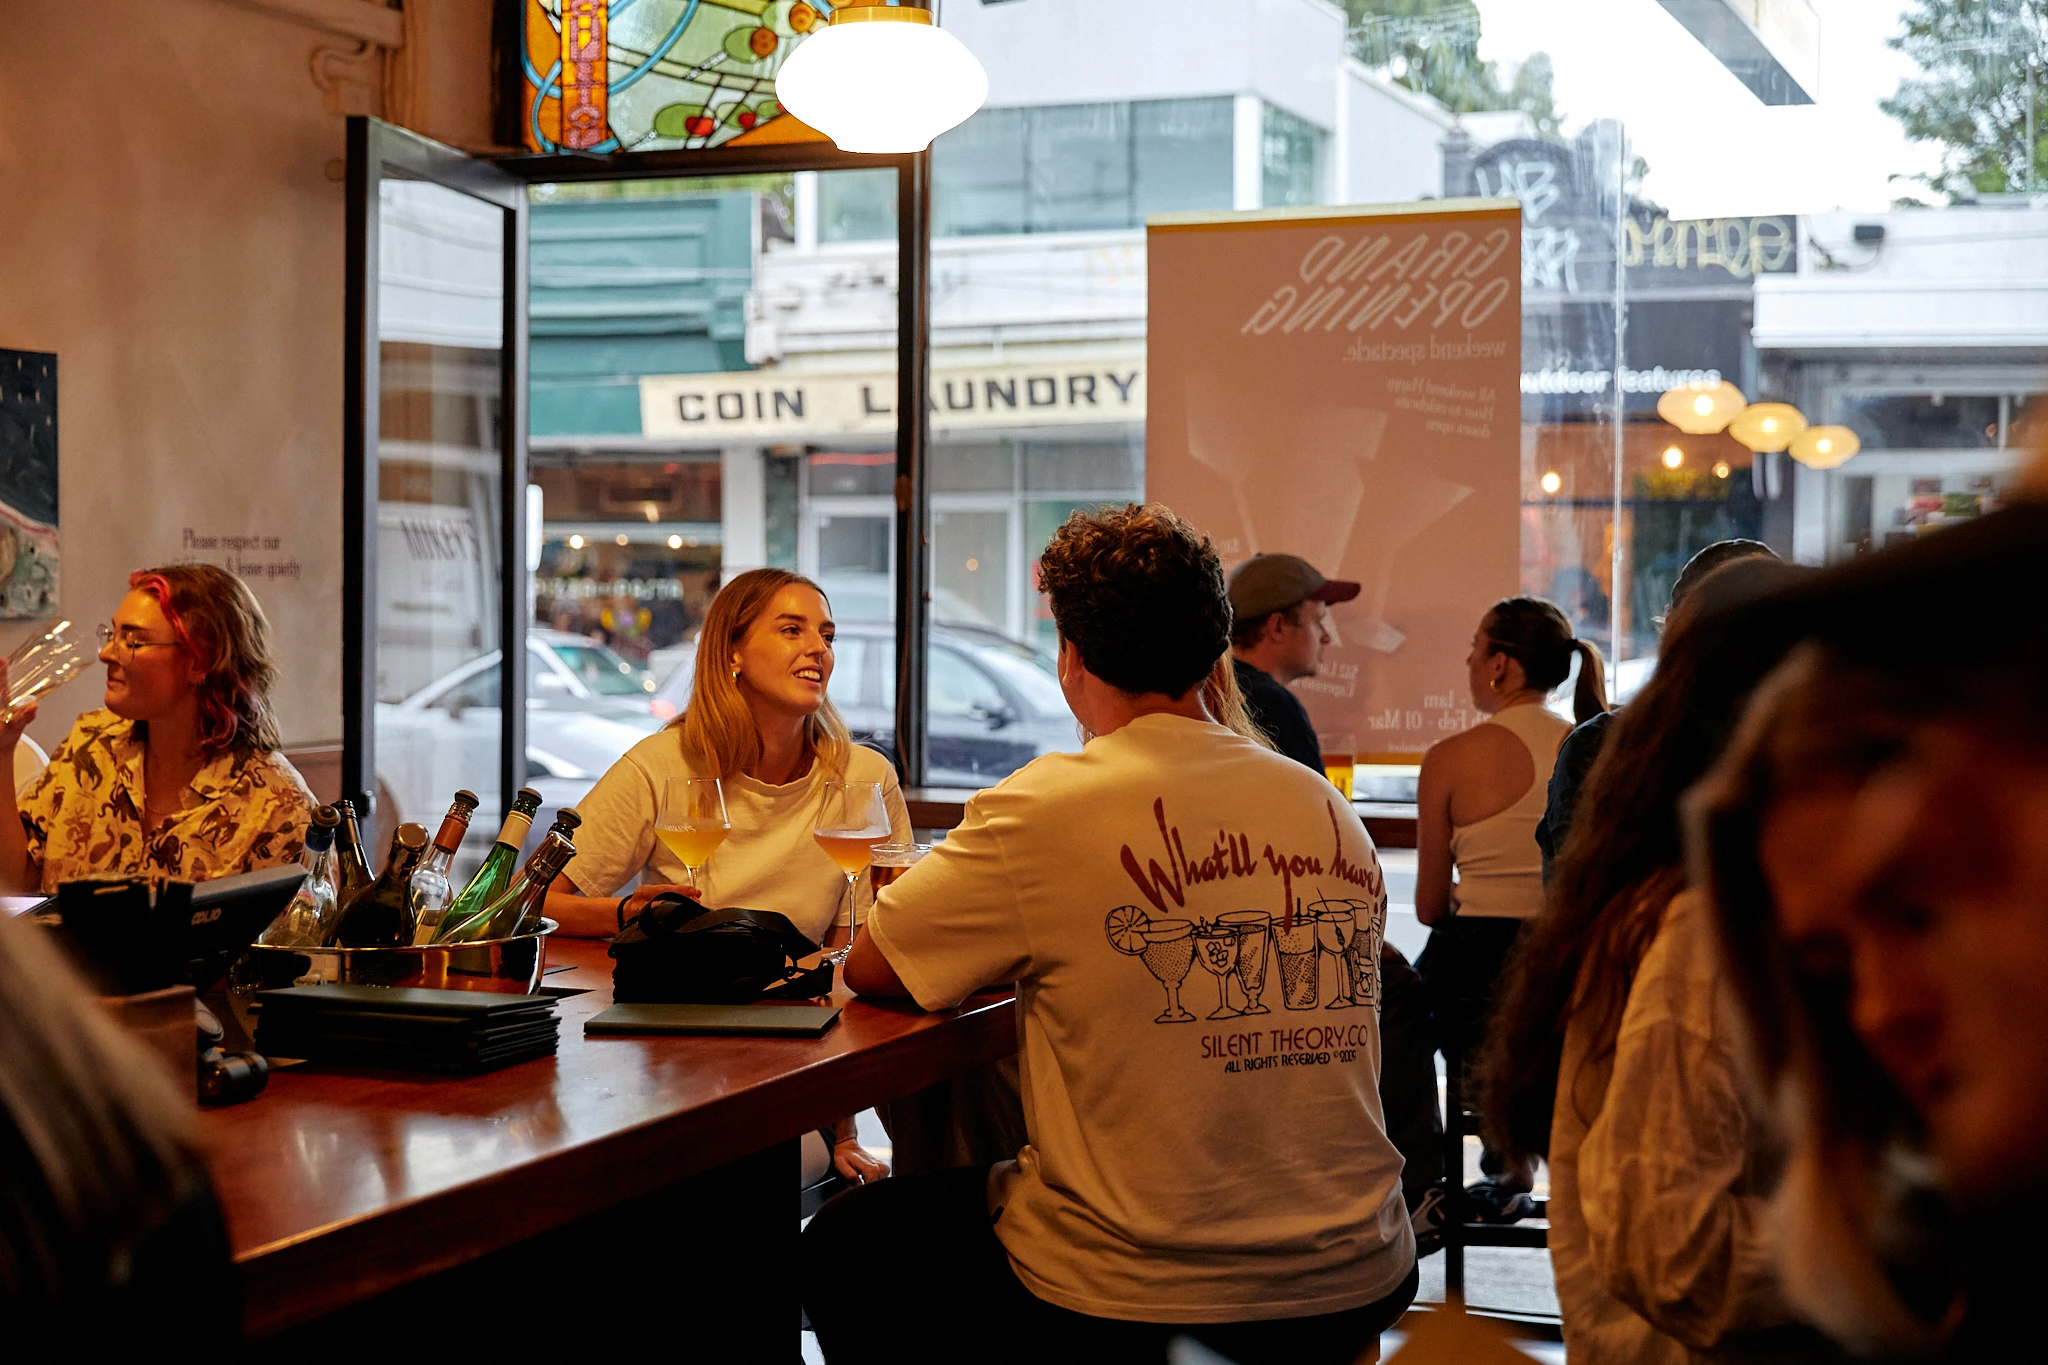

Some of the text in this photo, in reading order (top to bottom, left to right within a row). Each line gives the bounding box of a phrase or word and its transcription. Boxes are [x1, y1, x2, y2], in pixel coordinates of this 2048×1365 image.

[1520, 367, 1612, 394] utdoor
[678, 370, 1139, 423] COIN LUNDRY
[181, 527, 281, 552] Please respect our
[267, 557, 302, 580] quietly
[1120, 797, 1258, 914] What'll
[1263, 844, 1324, 936] you
[1201, 1024, 1368, 1058] SILENT THEORY.CO
[1224, 1060, 1241, 1074] ALL
[1244, 1055, 1279, 1071] RIGHTS
[1281, 1051, 1331, 1067] RESERVED
